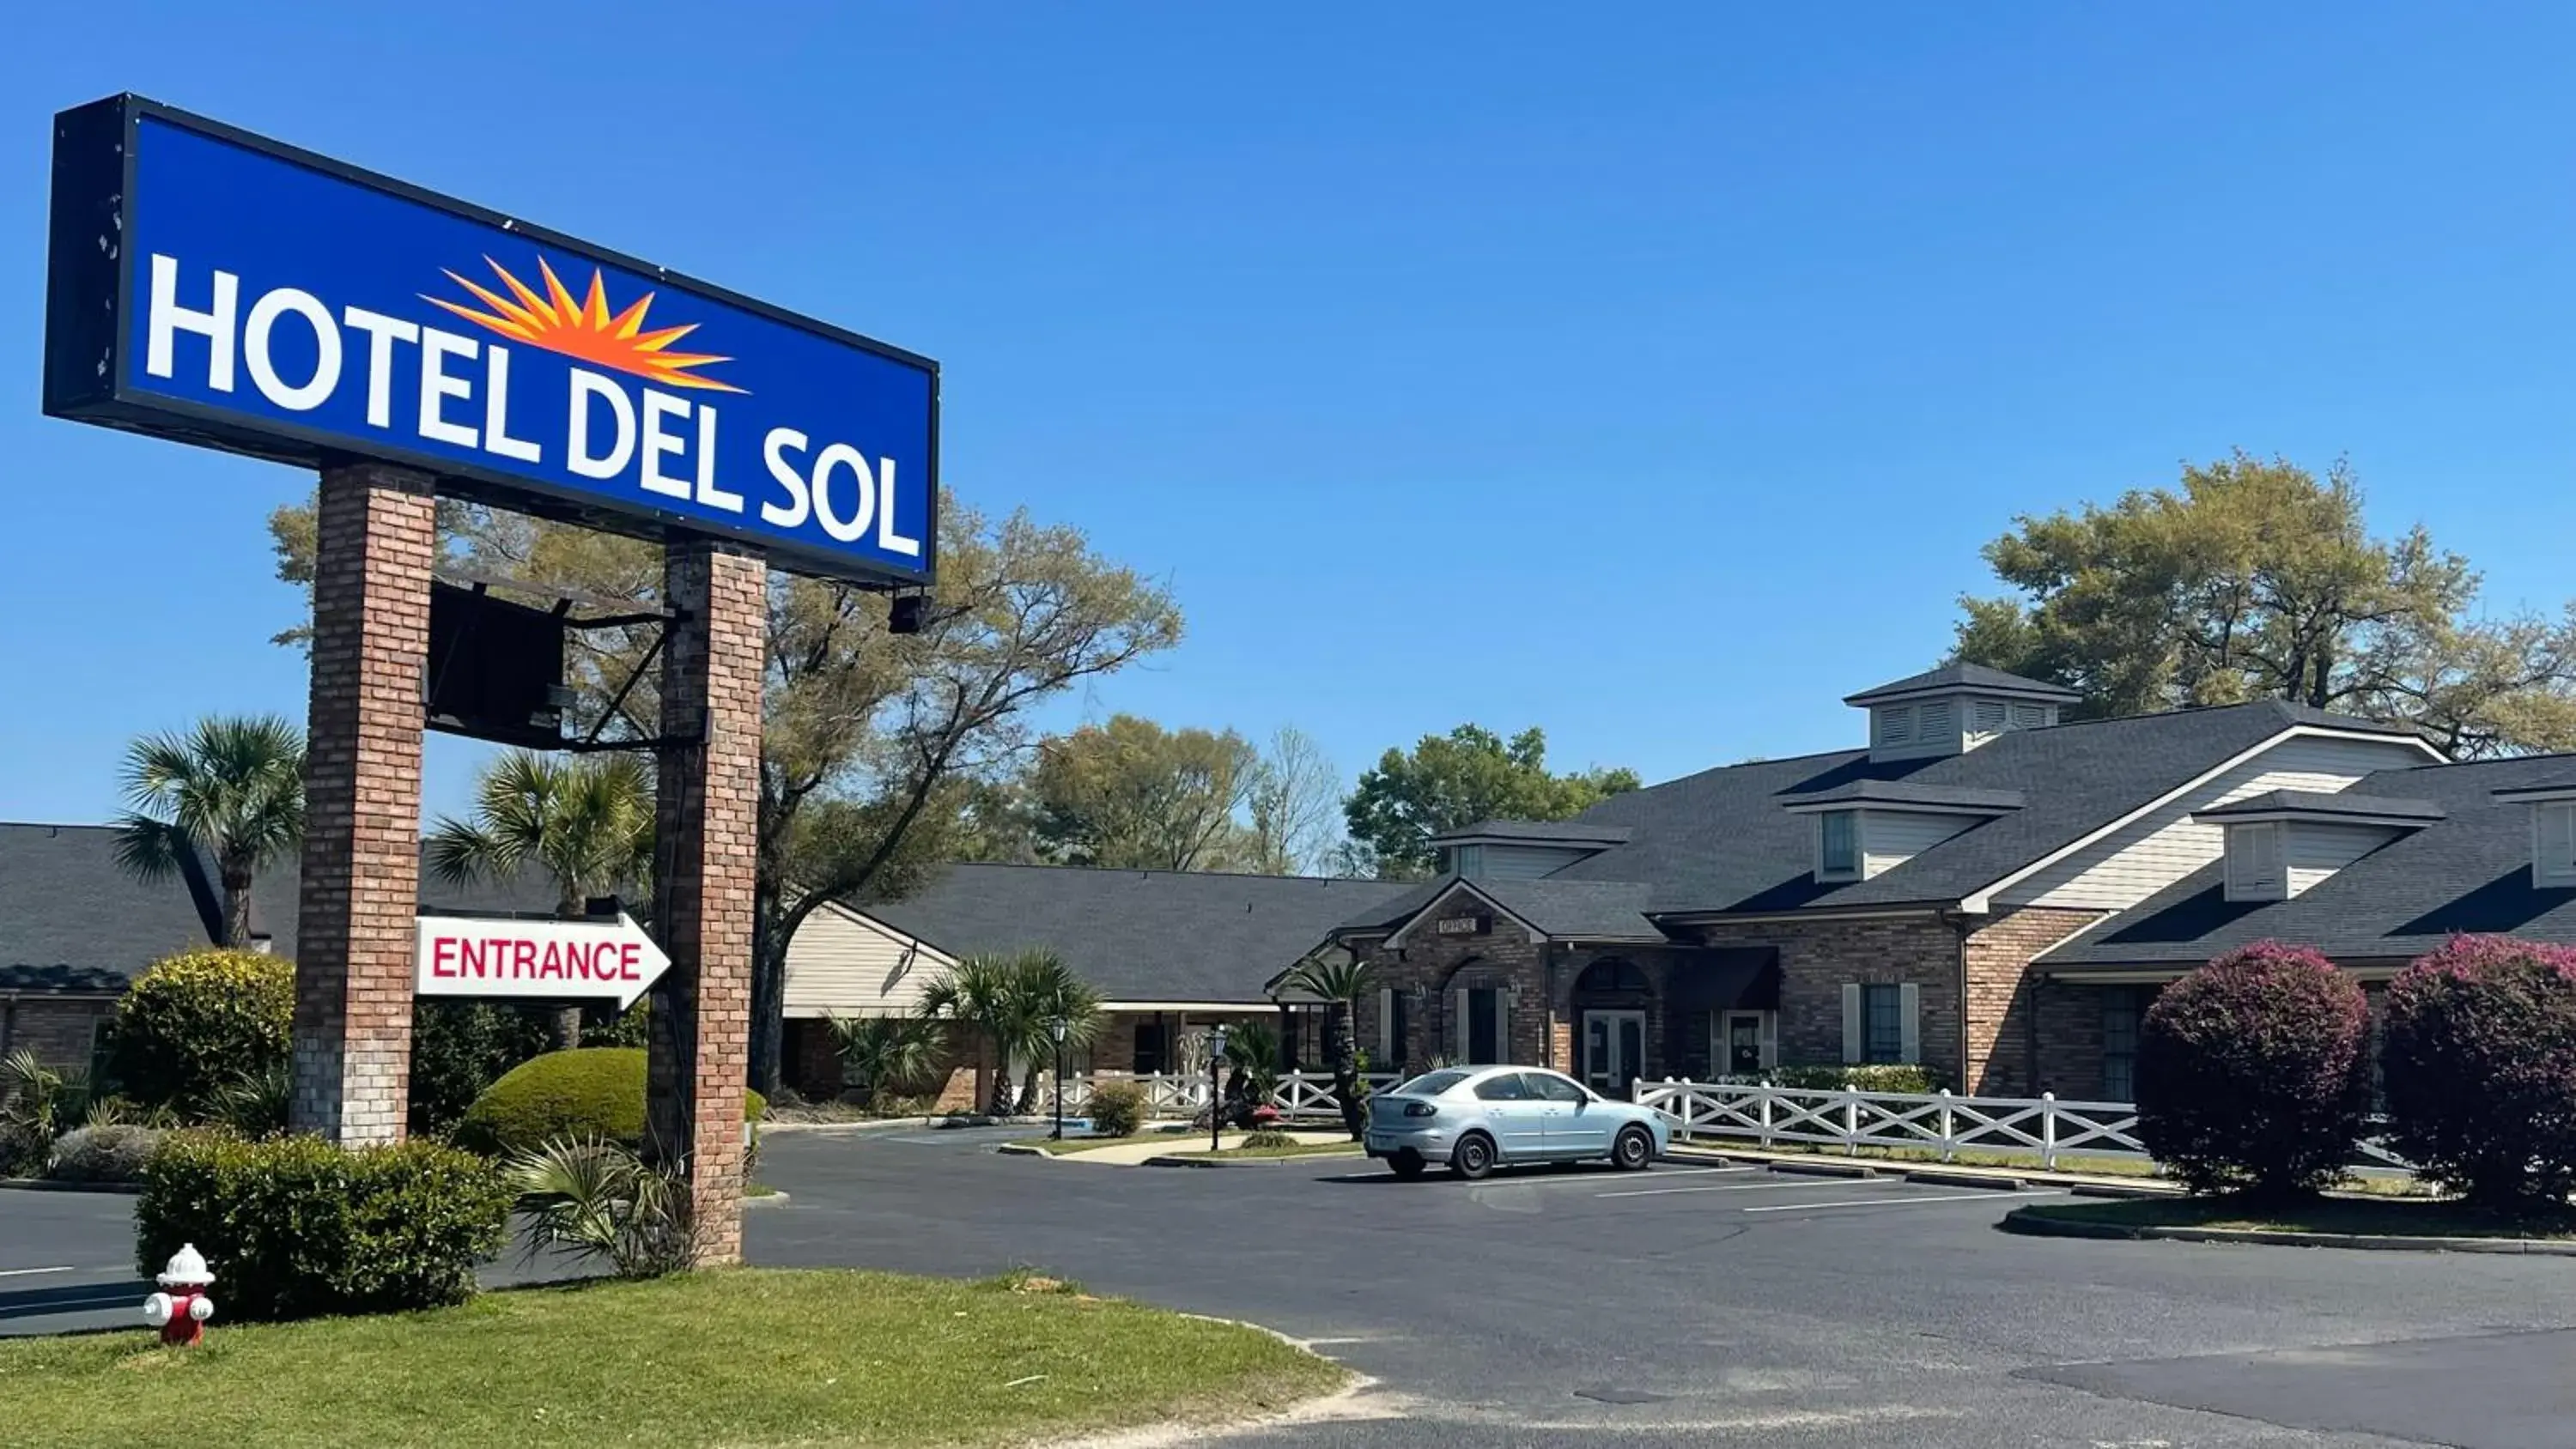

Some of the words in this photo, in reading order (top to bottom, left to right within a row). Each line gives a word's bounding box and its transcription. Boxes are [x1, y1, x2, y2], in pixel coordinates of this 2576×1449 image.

[147, 253, 541, 464] HOTEL
[567, 367, 744, 512] DEL
[761, 427, 920, 556] SOL
[432, 937, 641, 980] ENTRANCE
